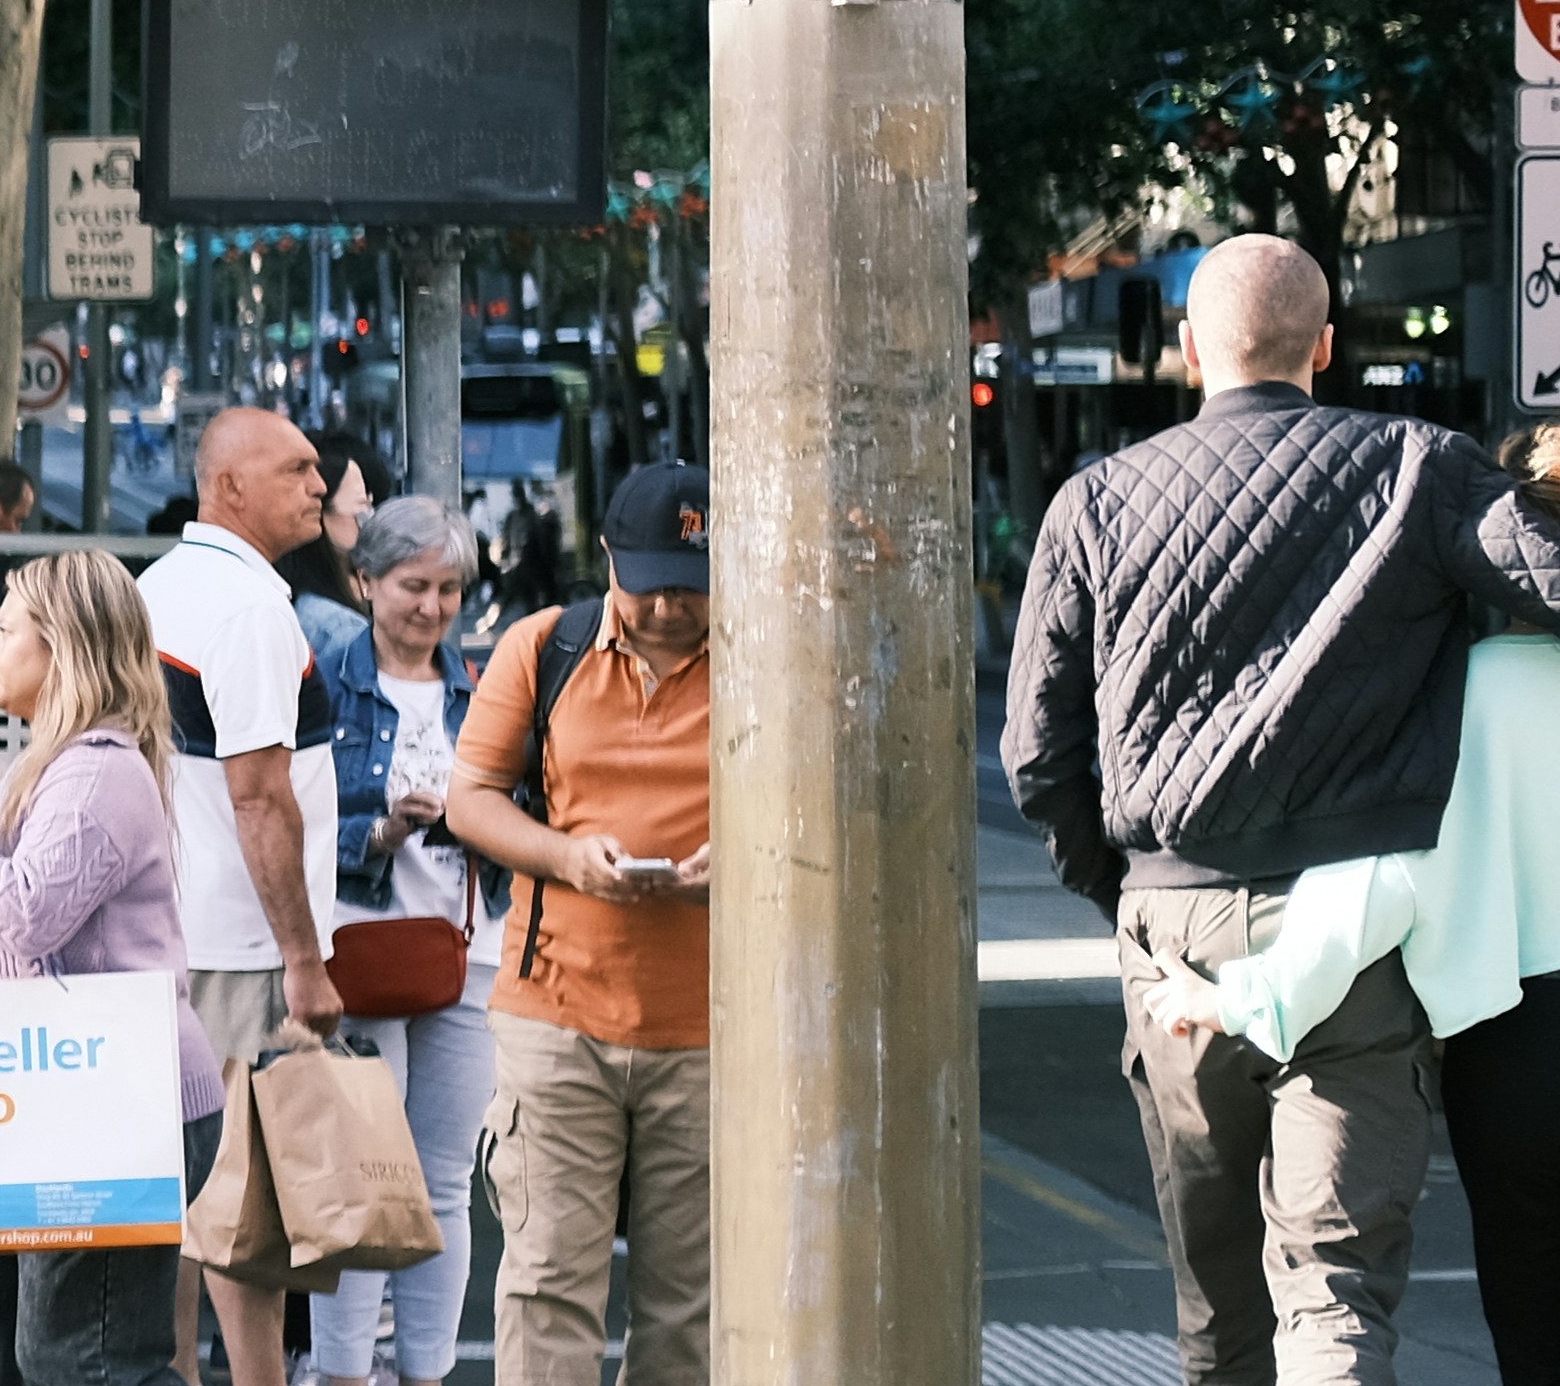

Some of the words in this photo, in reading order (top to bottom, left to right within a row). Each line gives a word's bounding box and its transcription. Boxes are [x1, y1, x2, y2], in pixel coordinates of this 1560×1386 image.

[77, 231, 124, 249] STOP
[66, 249, 135, 271] BEHIND
[70, 275, 133, 295] TRAMS
